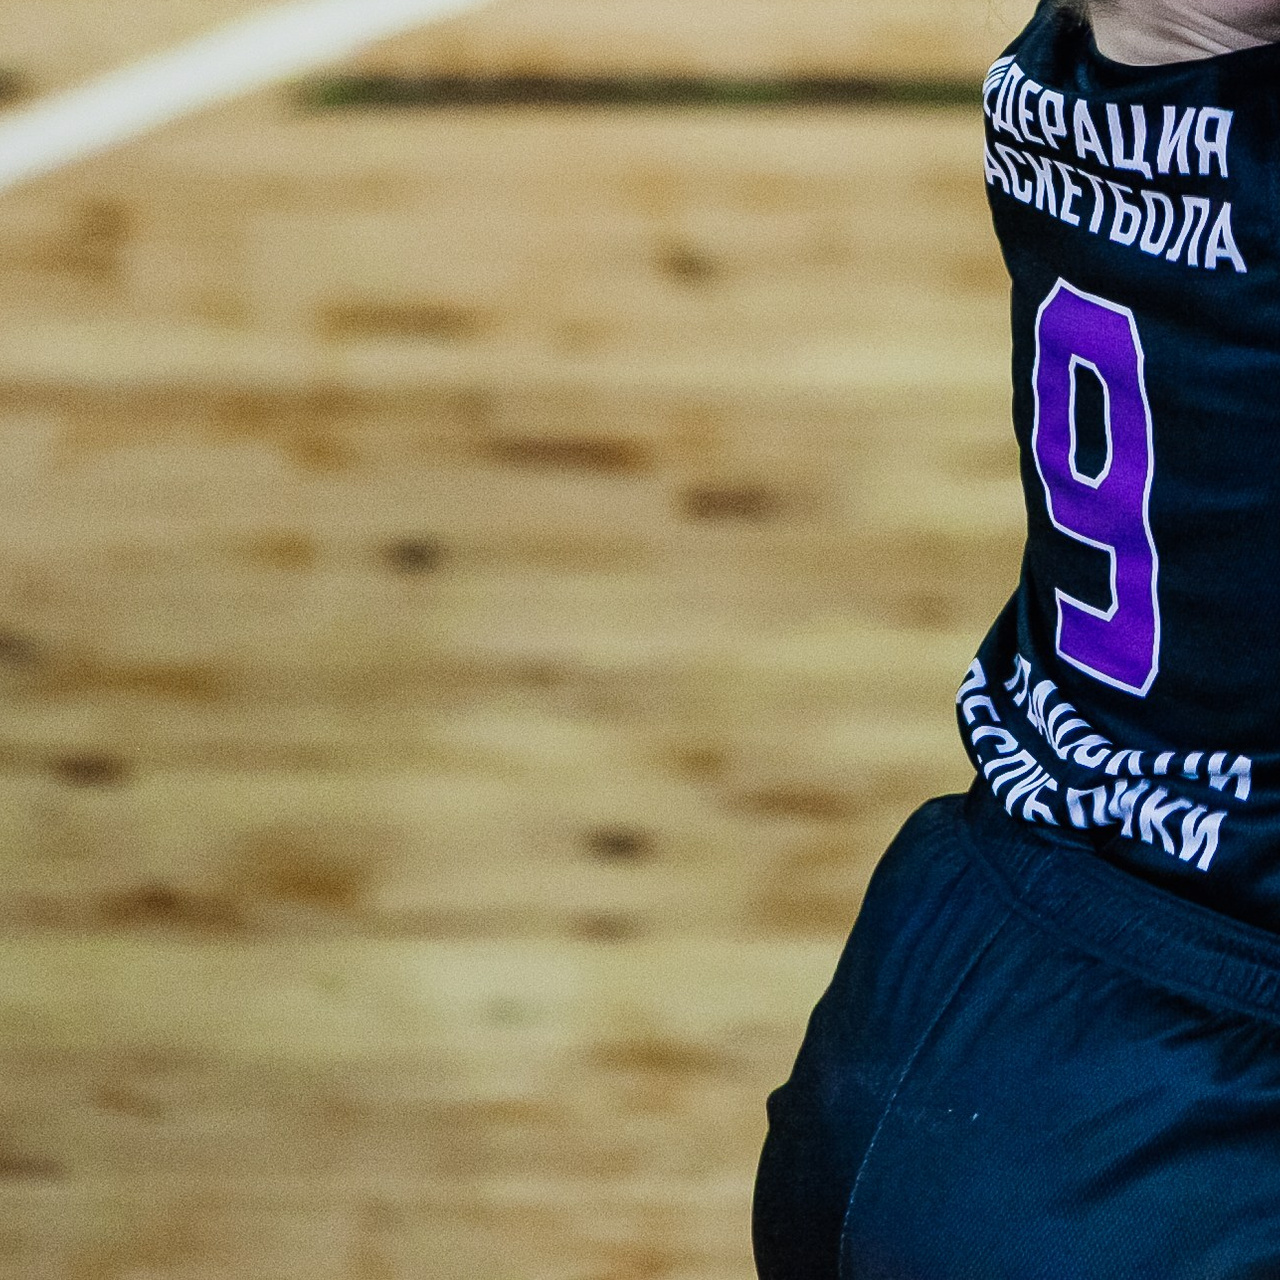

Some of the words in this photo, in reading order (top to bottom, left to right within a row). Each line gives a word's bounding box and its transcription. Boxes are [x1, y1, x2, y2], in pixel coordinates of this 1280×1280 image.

[983, 54, 1234, 180] ДЕРАЦИЯ
[984, 140, 1247, 273] АСКЕТБОЛА
[1033, 277, 1160, 698] 9
